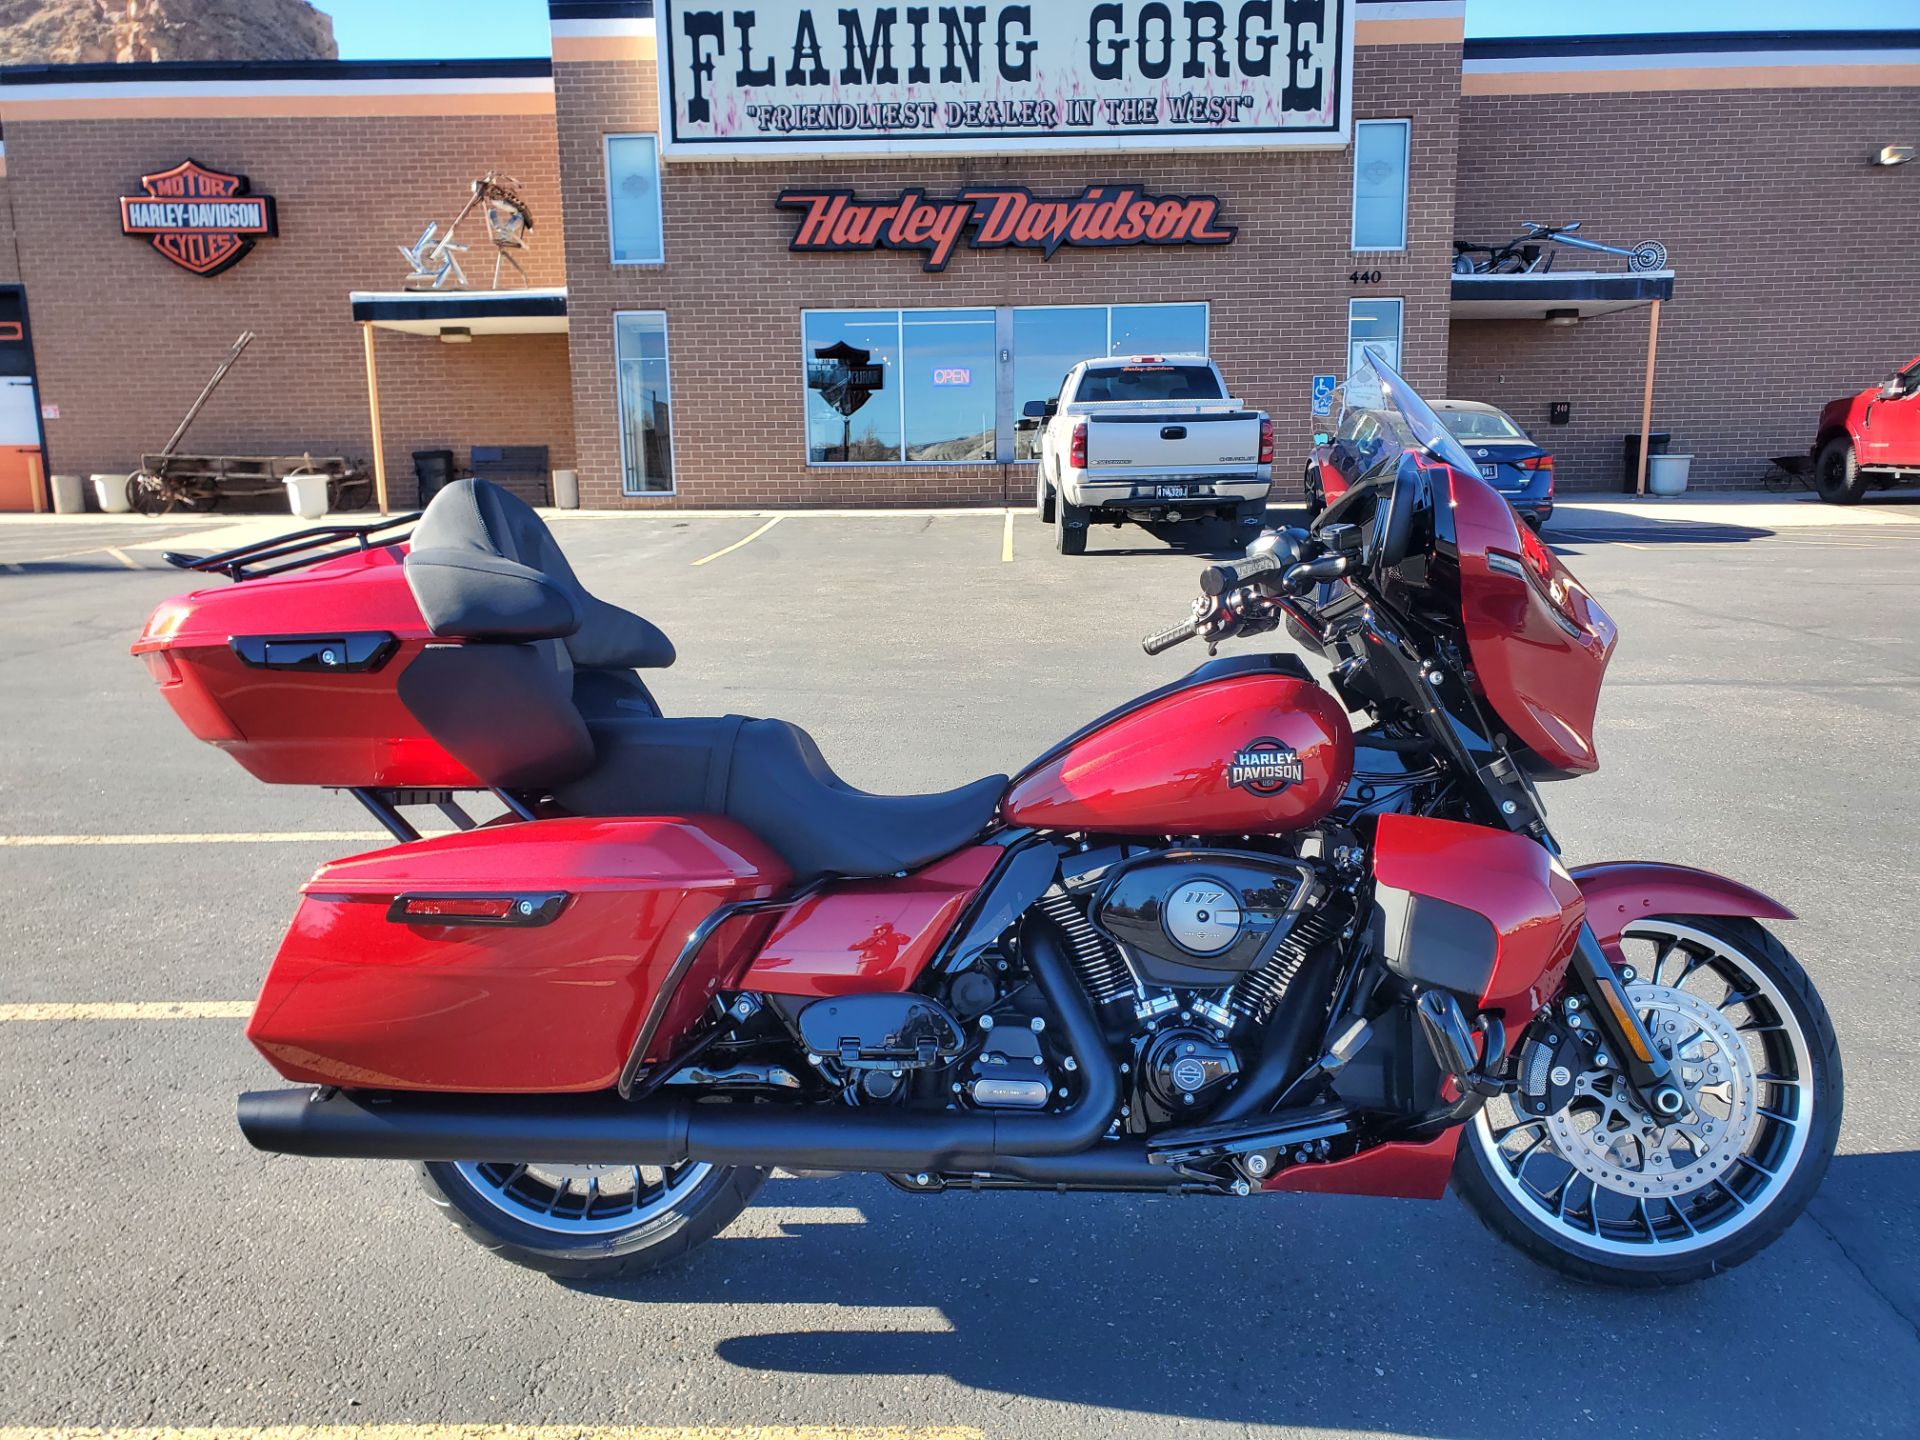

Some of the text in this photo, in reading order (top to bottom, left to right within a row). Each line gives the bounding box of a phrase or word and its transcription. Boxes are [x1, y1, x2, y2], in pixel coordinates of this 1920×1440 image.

[684, 0, 1325, 122] FLAMING GORGE
[747, 91, 1253, 133] "FRIENDLIEST DEALER IN THE WEST"
[156, 169, 225, 196] MOTOR
[129, 203, 261, 227] HARLEY-DAVIDSON
[780, 188, 1232, 265] Harley-Davidson
[163, 234, 231, 265] CYCLES
[1349, 270, 1382, 285] 440
[933, 368, 970, 384] OPEN
[1233, 765, 1302, 783] DAVIDSON
[1184, 891, 1224, 905] 117
